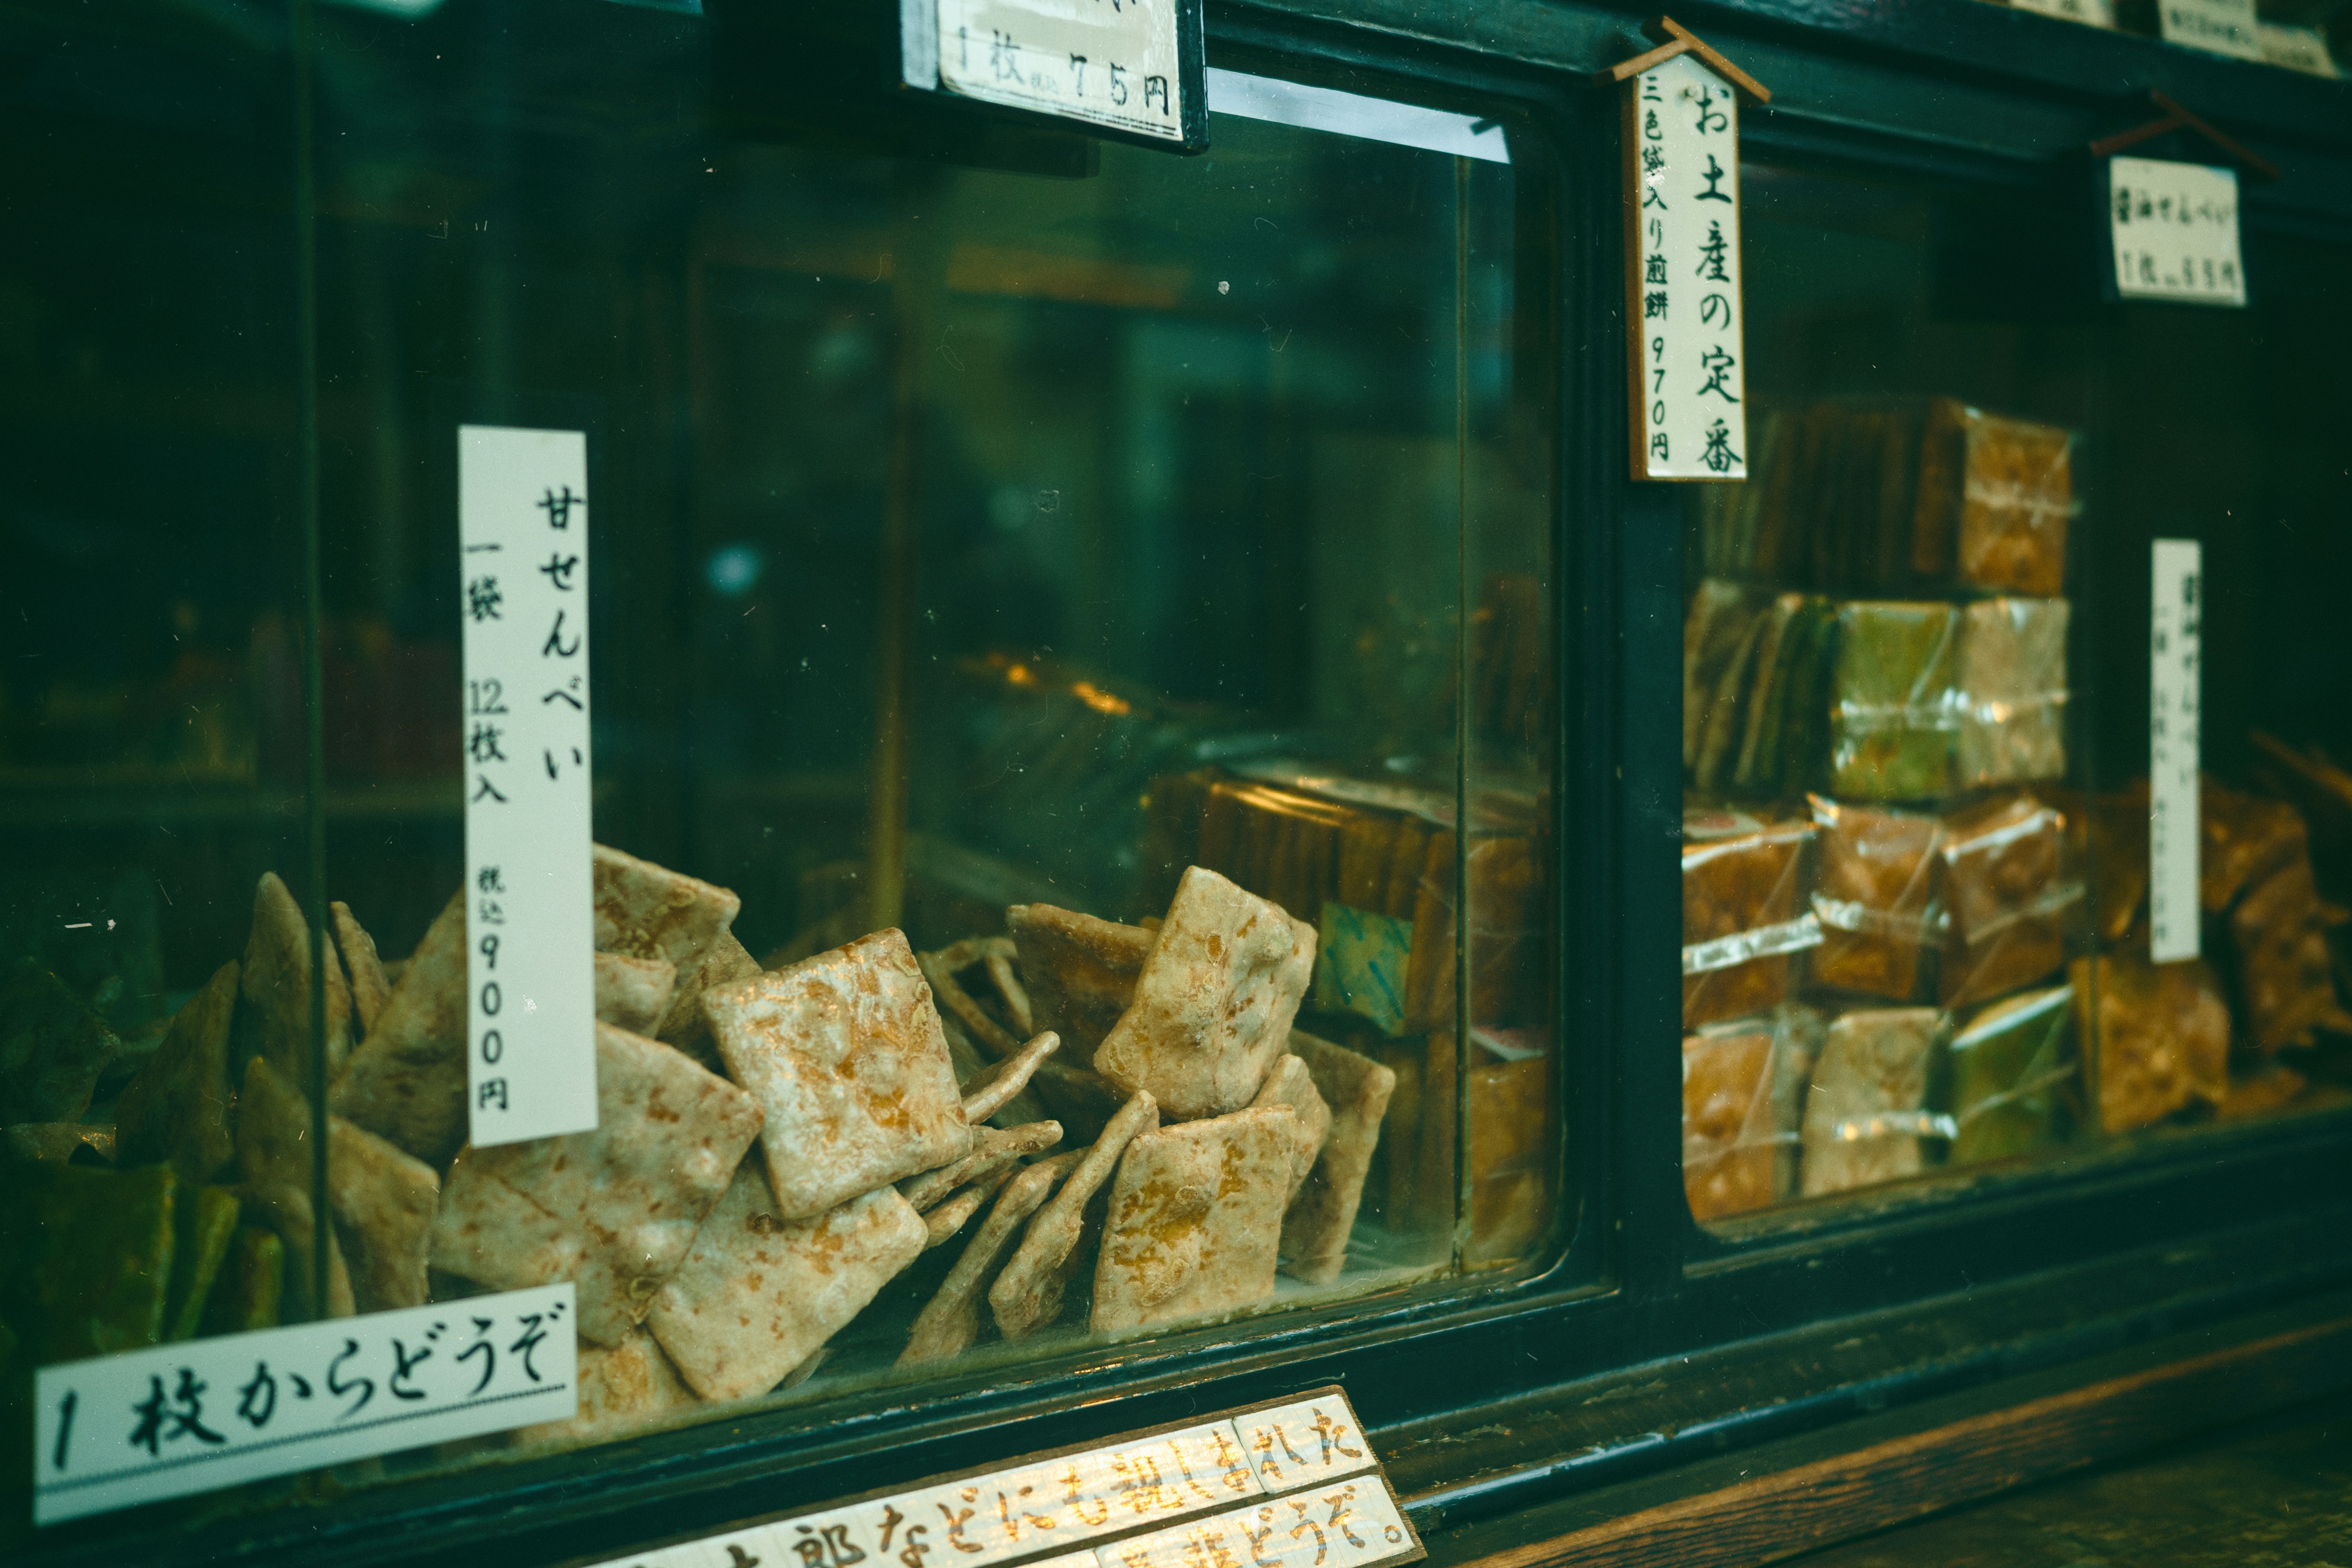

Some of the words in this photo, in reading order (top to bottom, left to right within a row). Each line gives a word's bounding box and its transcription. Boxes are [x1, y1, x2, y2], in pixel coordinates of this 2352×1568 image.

[1693, 84, 1743, 475] お土産の定番
[1651, 337, 1669, 462] 970円
[466, 543, 503, 622] 一袋
[537, 485, 586, 780] 甘せんべい
[468, 678, 508, 804] 12枚入
[478, 865, 508, 1111] 税込900円
[54, 1303, 567, 1470] 1枚からどうぞ
[632, 1406, 1363, 1568] 郎などにも親しまれた
